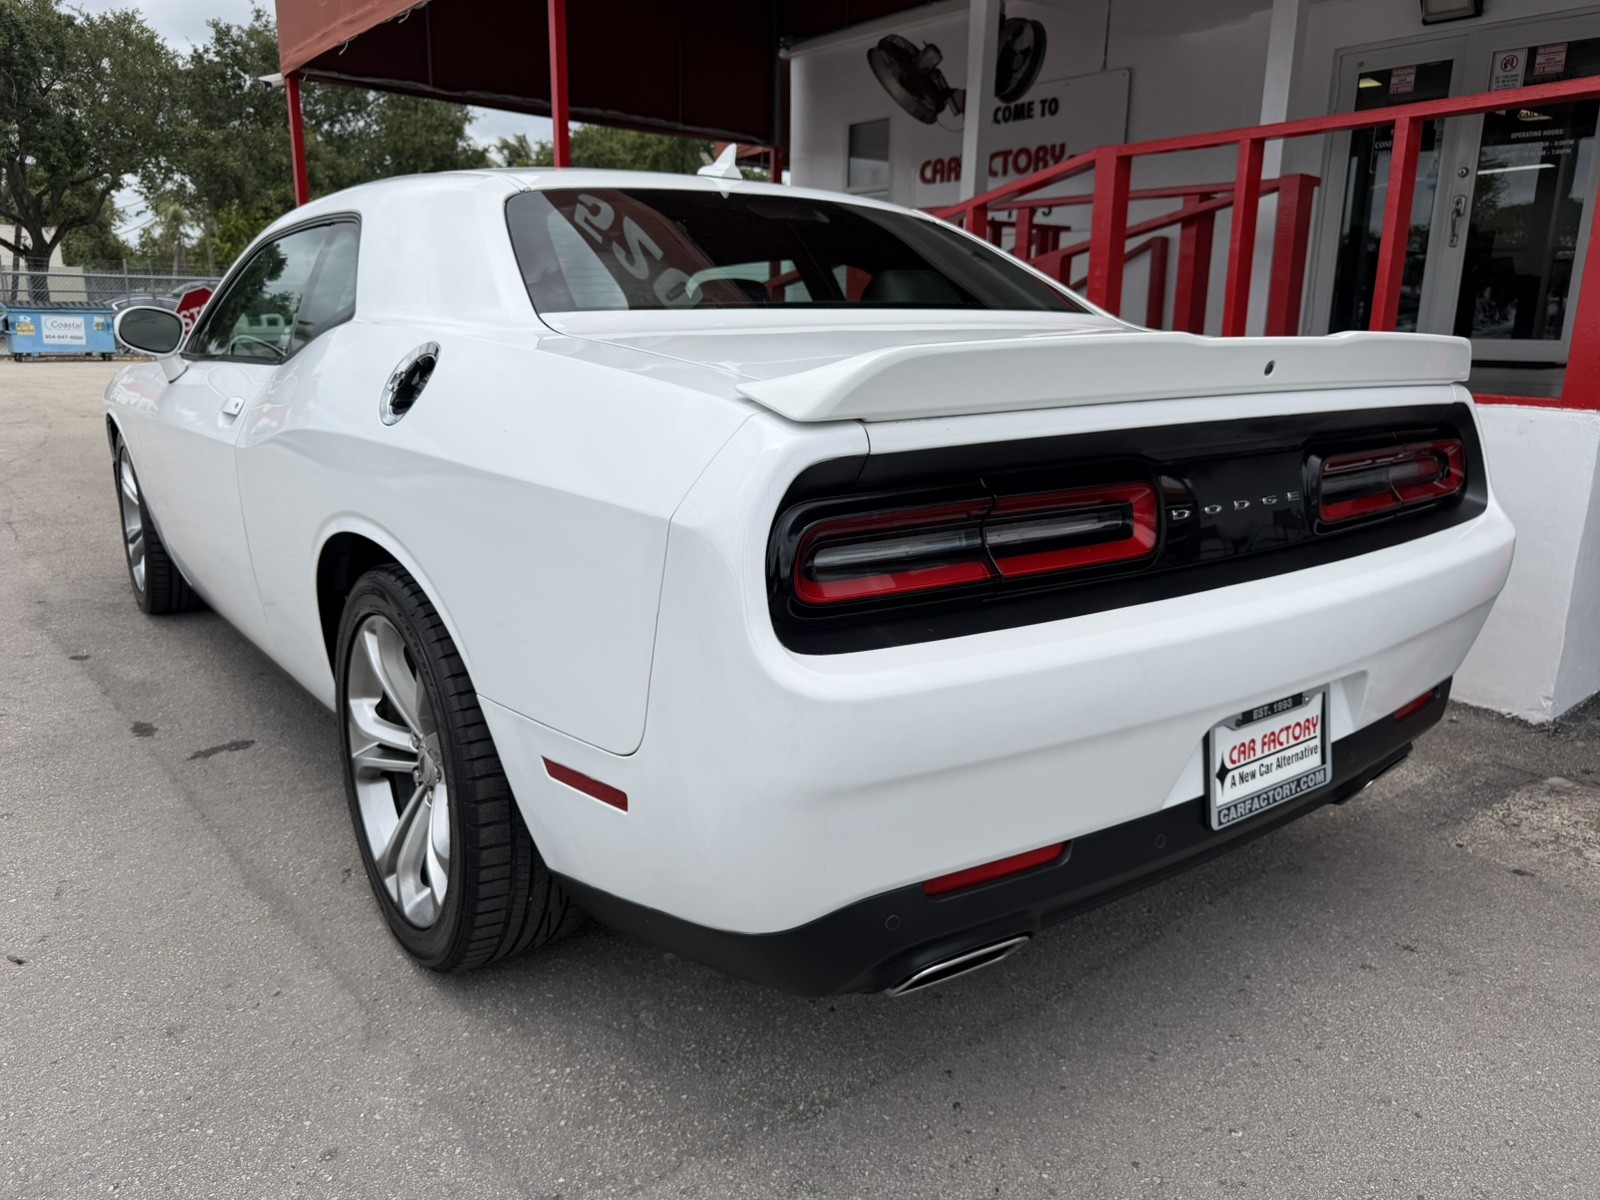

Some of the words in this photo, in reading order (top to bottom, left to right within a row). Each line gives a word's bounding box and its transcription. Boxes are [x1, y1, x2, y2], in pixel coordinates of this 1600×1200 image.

[992, 101, 1034, 125] COME
[1040, 97, 1059, 118] TO
[1511, 130, 1542, 139] OPERATING
[919, 156, 961, 185] CAR
[987, 143, 1067, 178] CTORY
[51, 320, 83, 330] Coastal
[180, 303, 208, 331] ST
[1172, 491, 1300, 520] DODGE
[1252, 707, 1272, 720] EST.
[1272, 699, 1293, 713] 1993
[1229, 738, 1256, 765] CAR
[1261, 715, 1319, 754] FACTORY
[1230, 774, 1237, 789] A
[1238, 768, 1256, 785] New
[1259, 762, 1274, 777] Car
[1275, 744, 1319, 771] Alternative
[1219, 769, 1325, 824] CARFACTORY.COM
